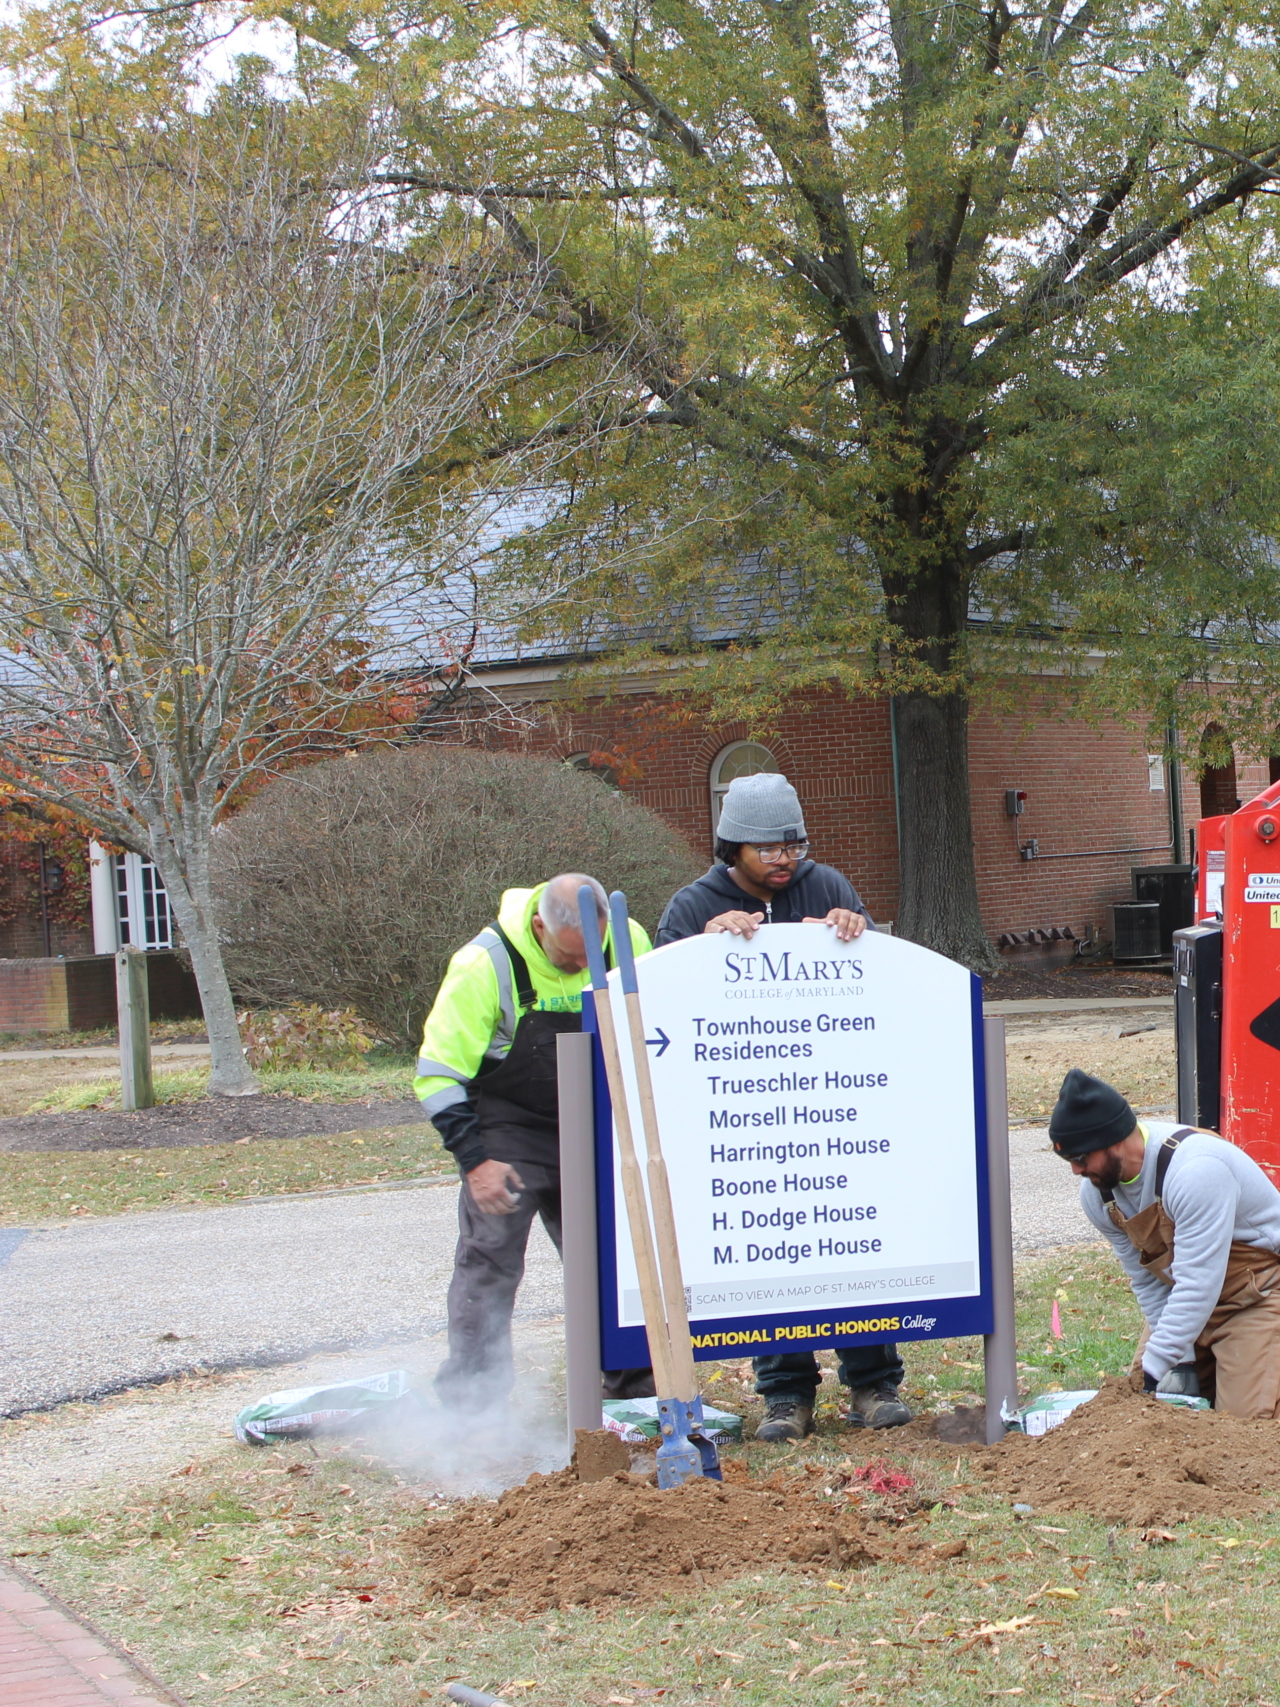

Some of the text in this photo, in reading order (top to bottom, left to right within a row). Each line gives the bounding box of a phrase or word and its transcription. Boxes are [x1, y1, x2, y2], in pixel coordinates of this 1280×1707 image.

[725, 986, 864, 1000] COLLEGE of MARYLAND
[692, 1012, 875, 1037] Townhouse Green
[694, 1040, 813, 1062] Residences
[707, 1070, 888, 1095] Trueschler House
[709, 1105, 858, 1129] Morsell House
[710, 1137, 891, 1165] Harrington House
[711, 1173, 848, 1198] Boone House
[712, 1204, 877, 1231] H. Dodge House
[713, 1237, 882, 1265] M. Dodge House
[696, 1275, 936, 1305] SCAN TO VIEW A MAP OF ST. MARY'S COLLEGE
[690, 1315, 937, 1349] NATIONAL PUBLIC HONORS College
